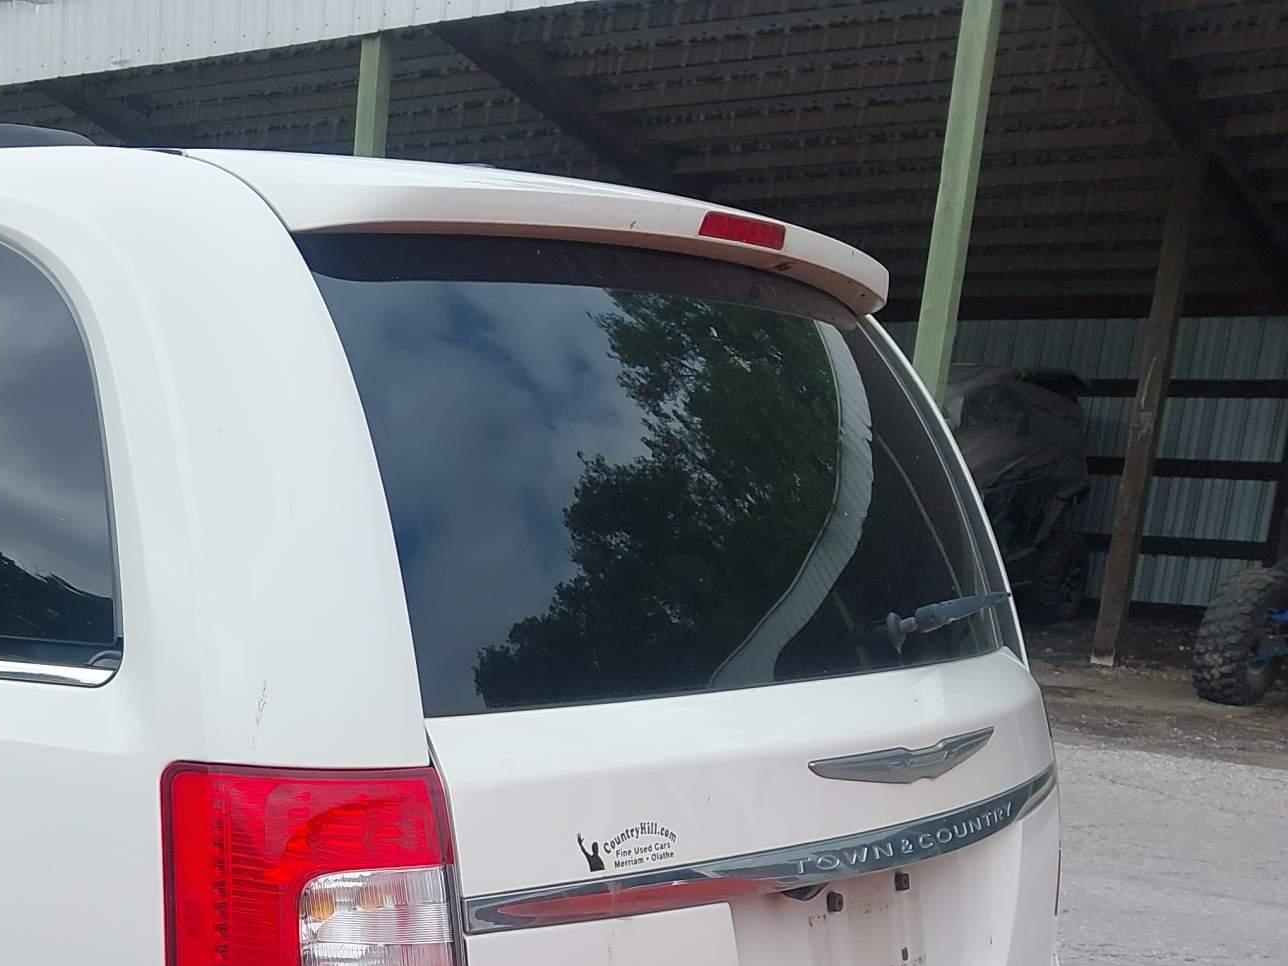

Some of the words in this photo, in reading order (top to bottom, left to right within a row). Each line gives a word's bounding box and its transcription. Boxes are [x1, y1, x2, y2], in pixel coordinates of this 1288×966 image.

[603, 821, 677, 854] CountryHill.com
[615, 847, 632, 858] Fine
[634, 845, 653, 855] Used
[654, 841, 671, 851] Cars
[614, 858, 645, 869] Merriam
[651, 851, 674, 862] Olathe
